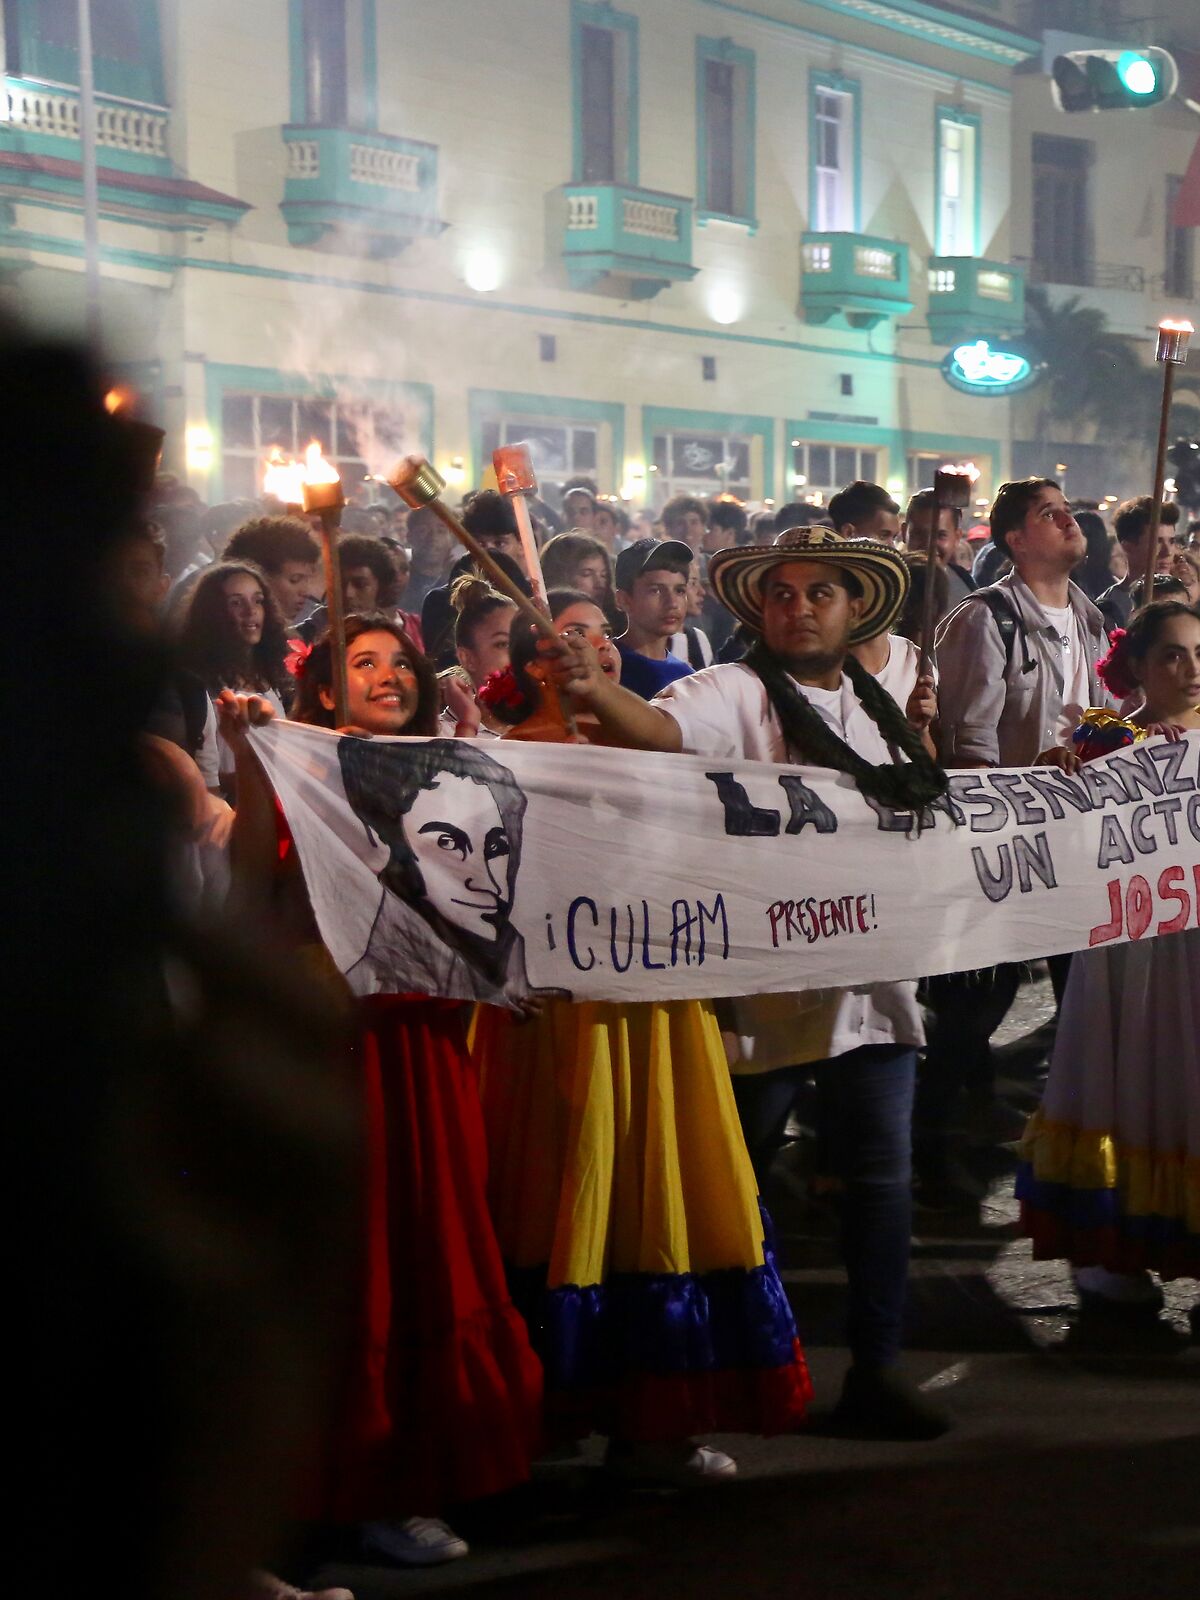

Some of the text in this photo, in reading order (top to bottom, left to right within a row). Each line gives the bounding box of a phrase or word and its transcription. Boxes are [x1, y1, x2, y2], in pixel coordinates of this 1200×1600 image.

[705, 772, 838, 836] LA
[971, 831, 1058, 902] UN
[766, 893, 879, 947] PRESENTE!
